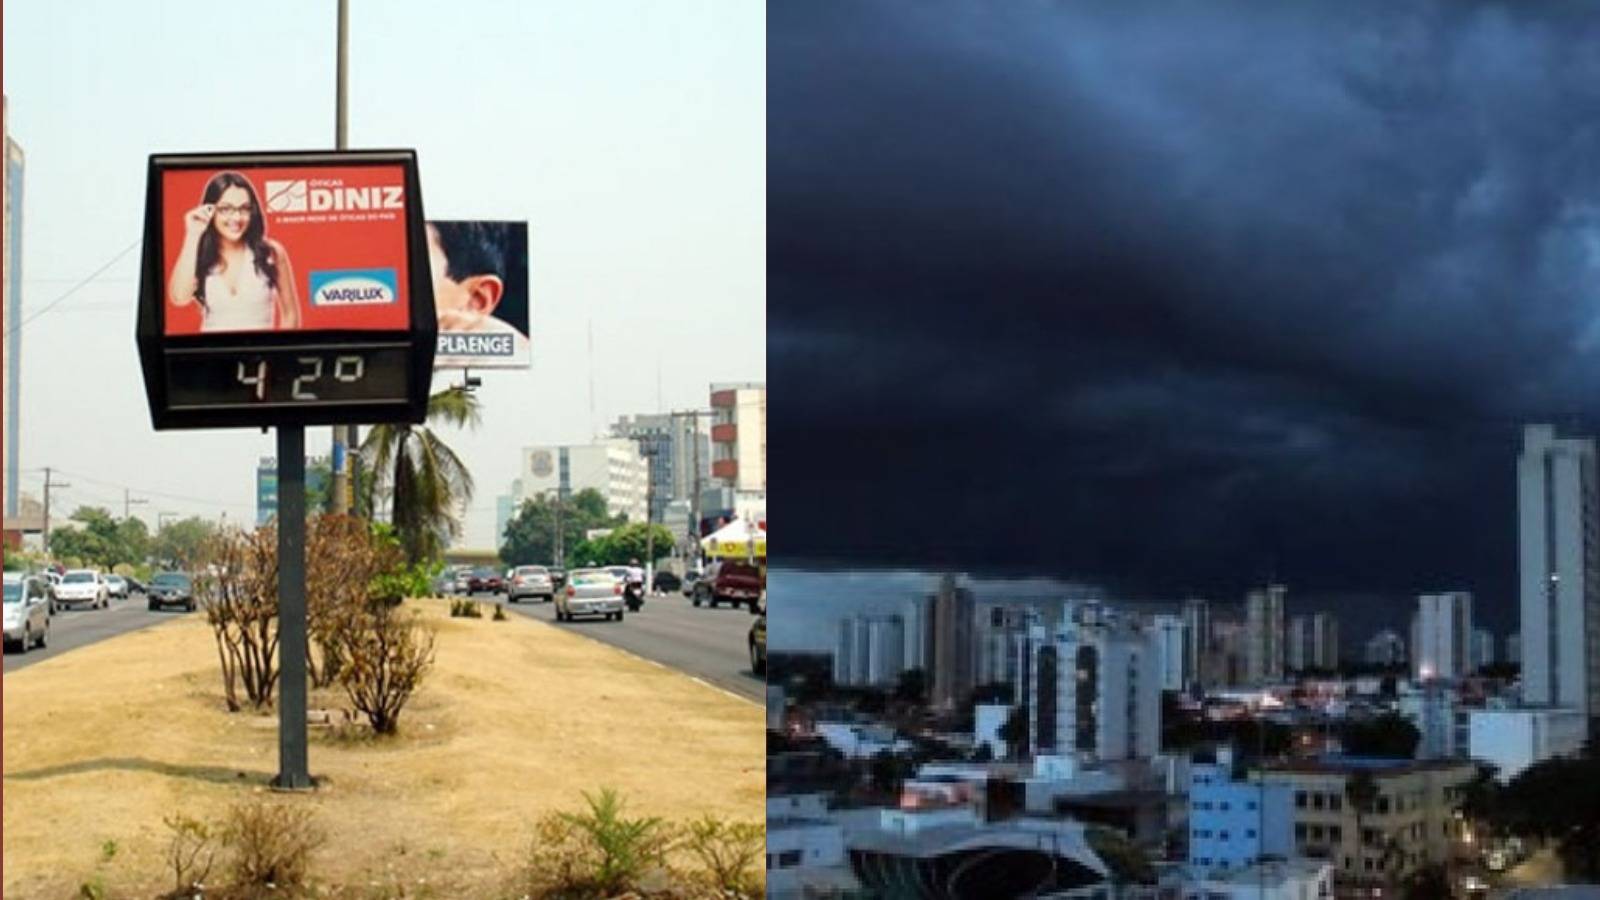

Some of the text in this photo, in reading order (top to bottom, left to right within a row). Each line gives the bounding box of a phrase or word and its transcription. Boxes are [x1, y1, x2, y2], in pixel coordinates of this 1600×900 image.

[309, 186, 403, 211] DINIZ
[322, 288, 384, 302] VARILUX
[437, 336, 512, 353] PLAENGE
